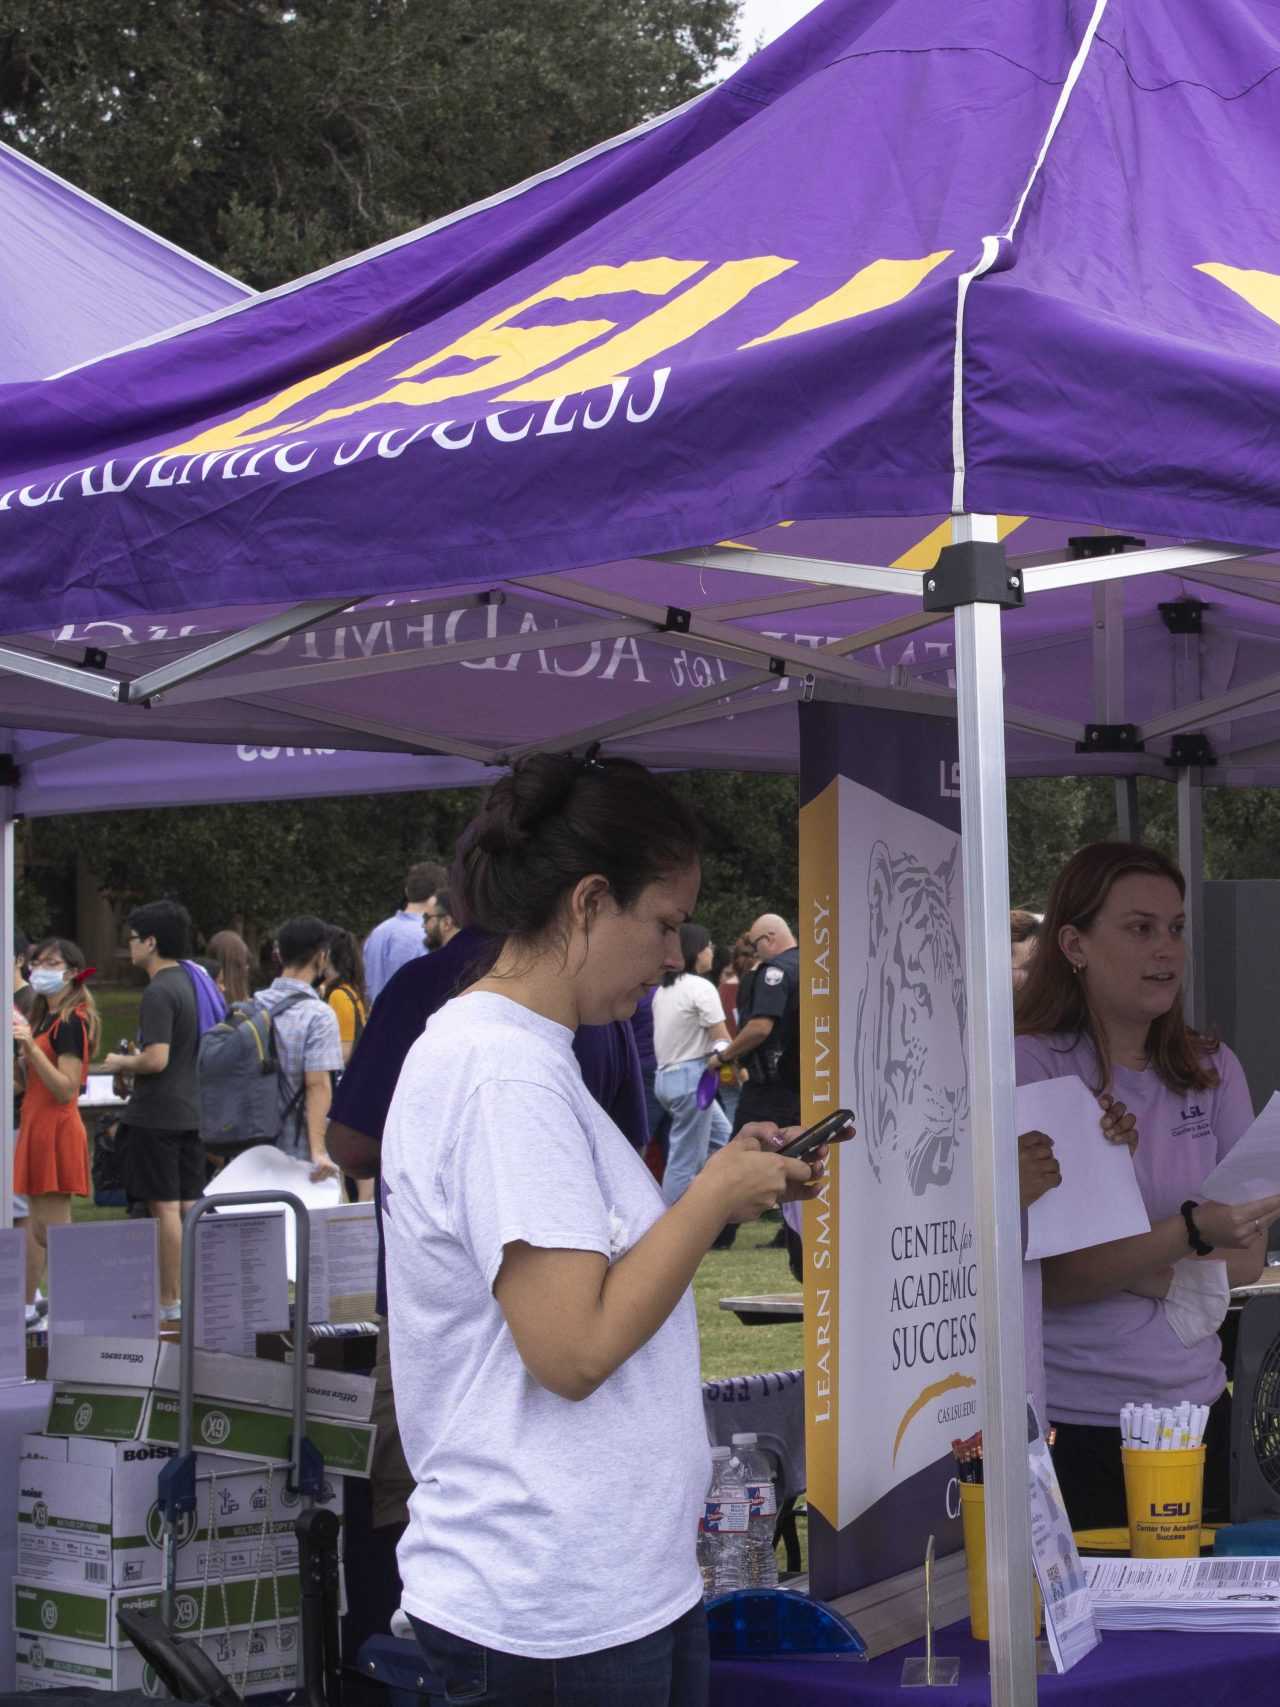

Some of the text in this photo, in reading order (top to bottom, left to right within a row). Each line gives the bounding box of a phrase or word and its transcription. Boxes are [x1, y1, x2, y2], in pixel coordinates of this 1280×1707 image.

[812, 1015, 830, 1104] LIVE
[891, 1220, 973, 1264] CENTER for
[890, 1264, 977, 1312] ACADEMIC
[815, 1288, 830, 1423] LEARN
[892, 1312, 977, 1371] SUCCESS
[1151, 1503, 1190, 1516] LSU
